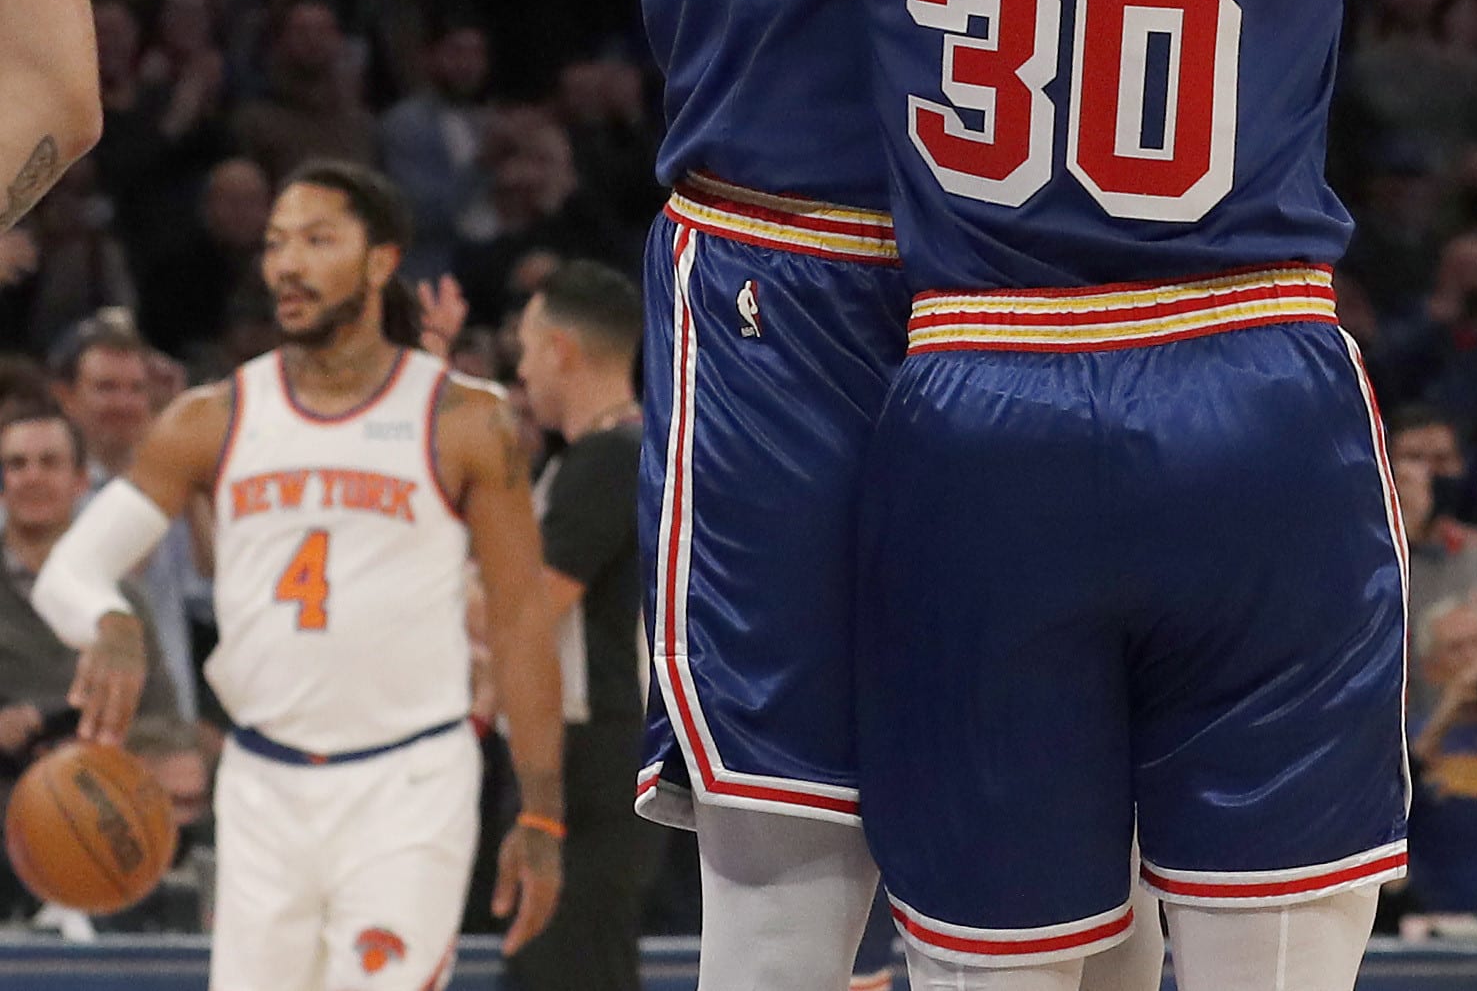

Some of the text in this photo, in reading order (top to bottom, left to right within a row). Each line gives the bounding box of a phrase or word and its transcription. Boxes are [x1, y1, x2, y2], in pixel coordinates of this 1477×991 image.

[230, 468, 419, 524] NEW YORK
[273, 528, 331, 631] 4
